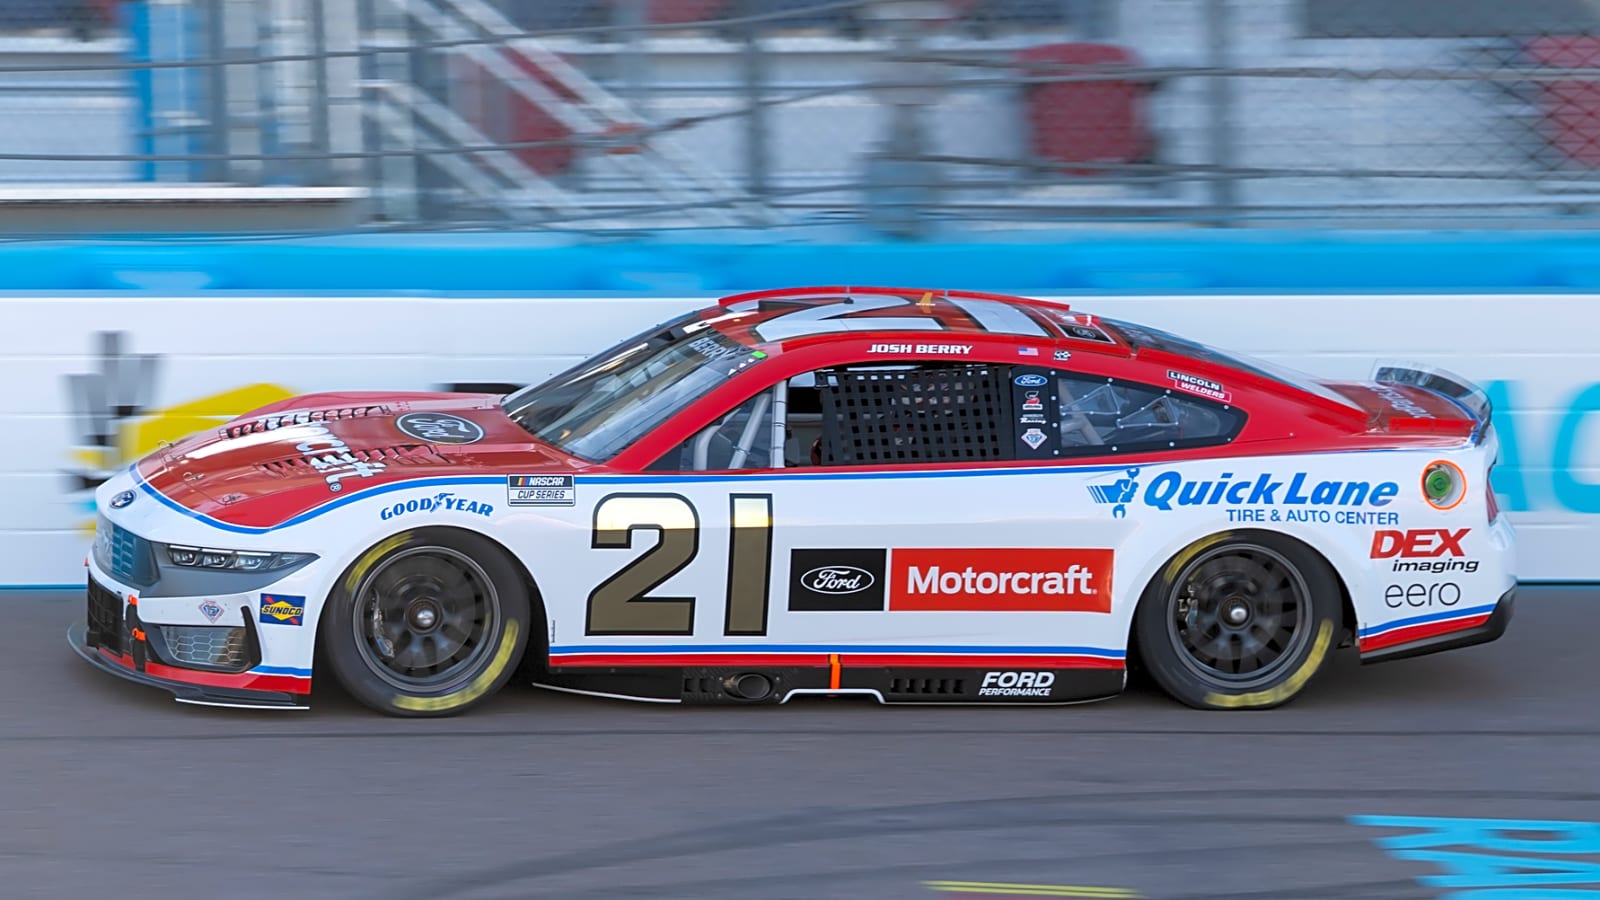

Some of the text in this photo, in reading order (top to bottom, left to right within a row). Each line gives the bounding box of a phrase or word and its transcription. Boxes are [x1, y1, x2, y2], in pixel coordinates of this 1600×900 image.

[867, 343, 973, 354] JOSH BERRY
[1170, 371, 1220, 391] LINCOLN
[1180, 382, 1225, 399] WELDERS
[528, 477, 565, 486] NASCAR
[518, 490, 565, 499] CUP SERIES
[1144, 470, 1399, 510] Quick Lane
[380, 493, 494, 521] GOODYEAR
[1226, 509, 1399, 525] TIRE & AUTO CENTER
[1370, 528, 1472, 559] DEX
[585, 493, 774, 637] 21
[1392, 558, 1480, 573] imaging
[907, 565, 1093, 595] Motorcraft
[1385, 582, 1461, 608] eero
[262, 604, 303, 616] SUNOCO
[981, 672, 1055, 688] FORD
[978, 687, 1051, 696] PERFORMANCE
